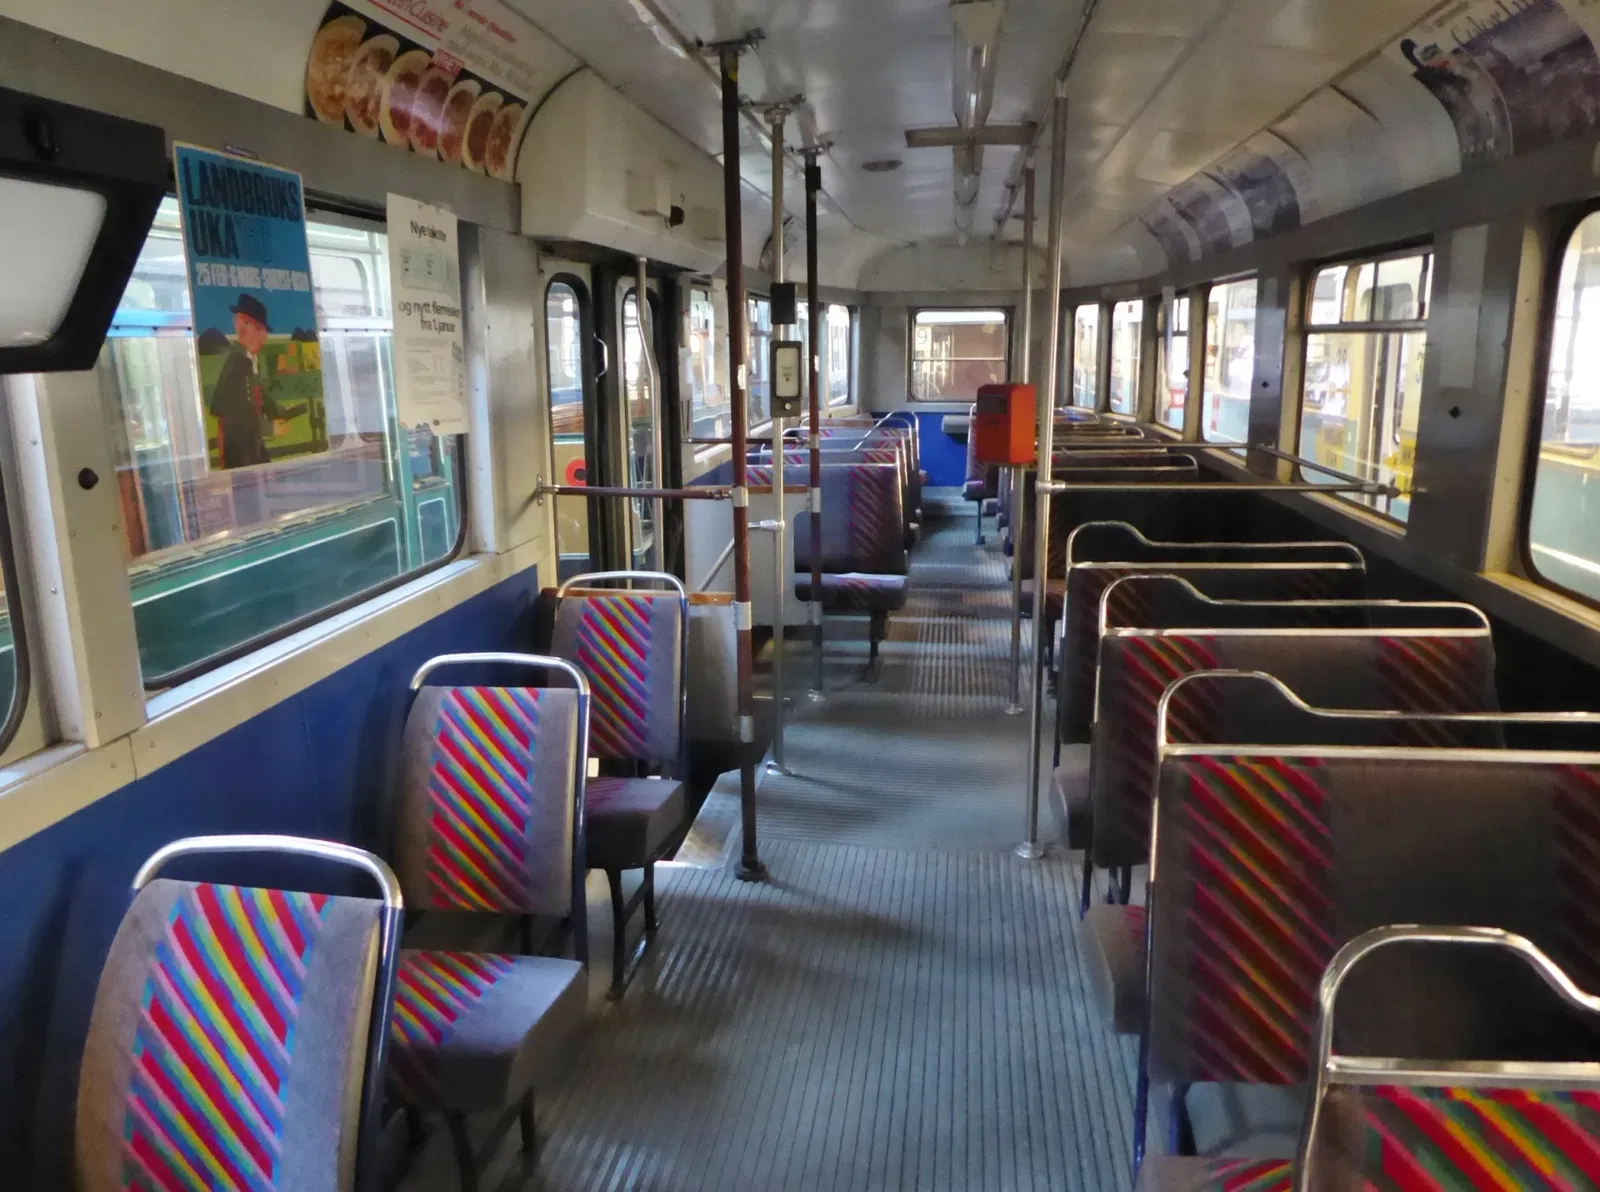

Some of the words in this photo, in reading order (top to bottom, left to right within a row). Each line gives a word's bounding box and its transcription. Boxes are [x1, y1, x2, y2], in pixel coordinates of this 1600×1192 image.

[182, 156, 300, 222] LANDBRUKS
[188, 207, 240, 260] UKA
[410, 219, 427, 239] Nye
[398, 301, 412, 316] og
